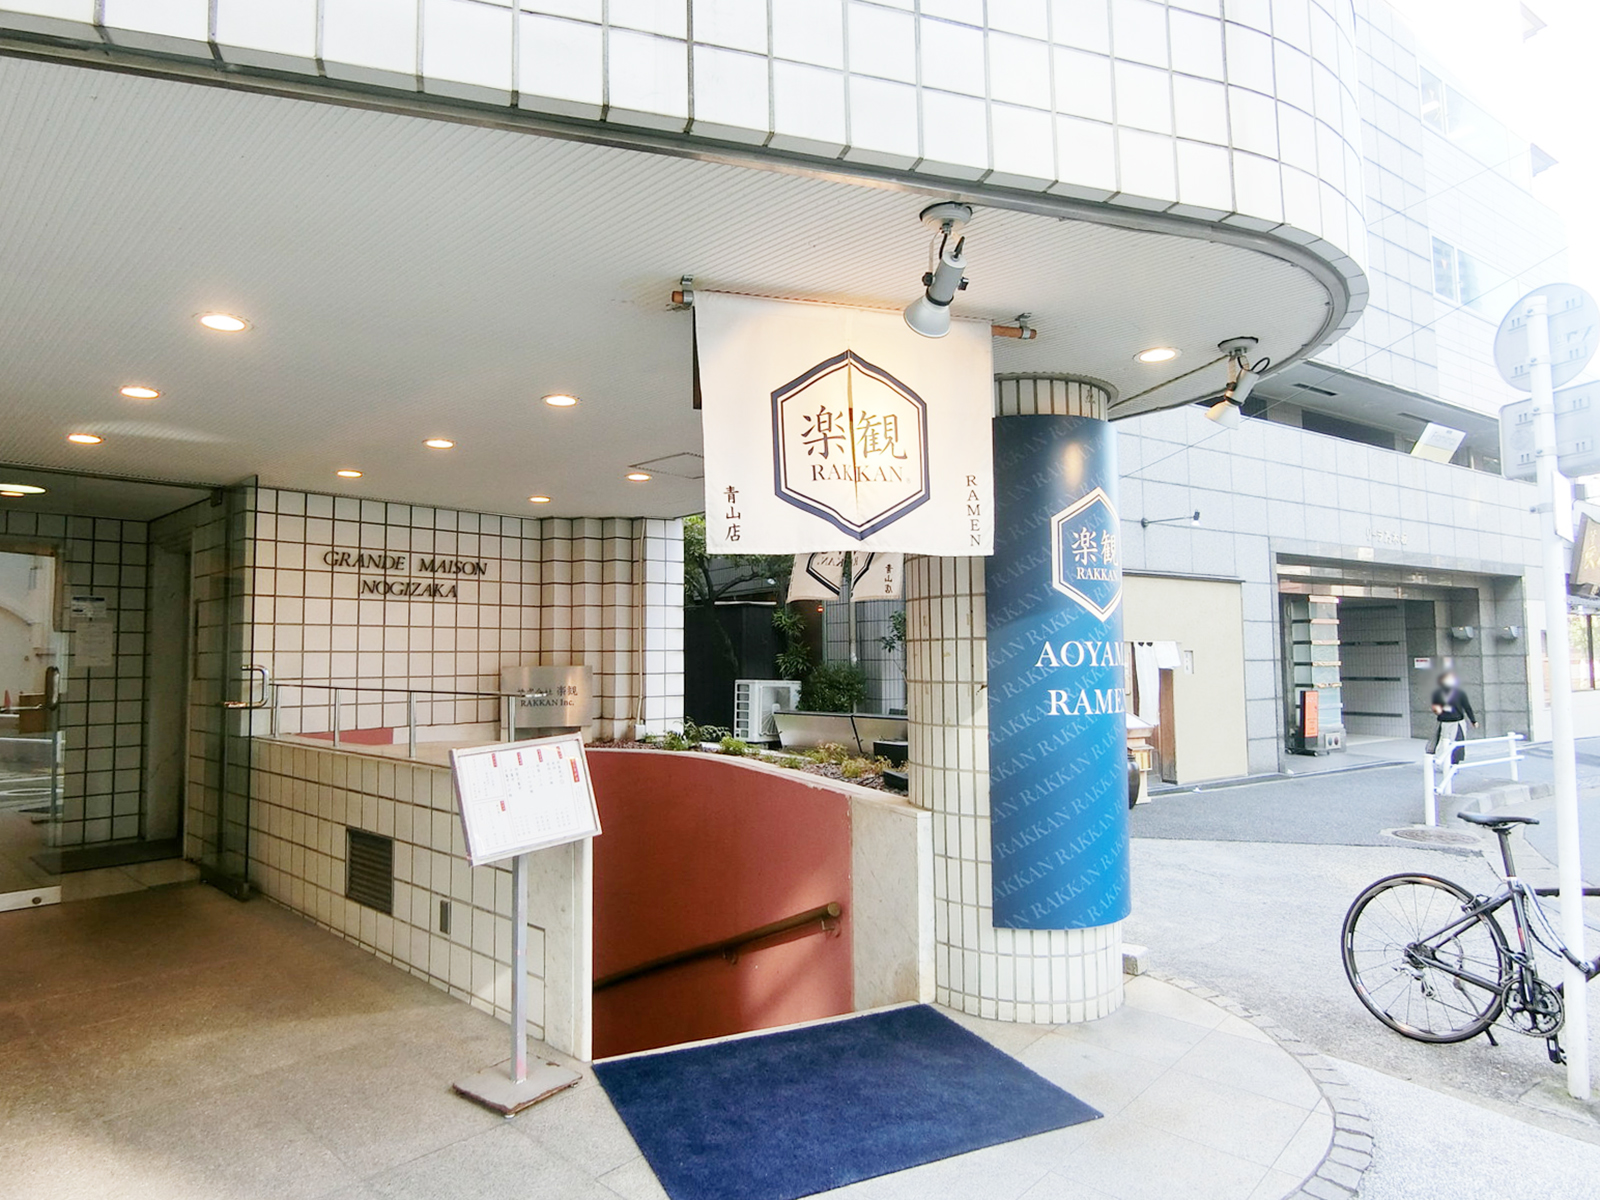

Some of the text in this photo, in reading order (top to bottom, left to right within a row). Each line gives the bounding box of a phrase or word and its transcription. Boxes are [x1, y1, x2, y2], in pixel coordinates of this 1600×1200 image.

[800, 404, 908, 460] 楽観
[811, 464, 904, 483] RAKKAN
[723, 484, 742, 542] 青山店
[966, 474, 982, 547] RAMEN
[322, 550, 488, 576] GRANDE MAISON
[360, 579, 458, 599] NOGIZAKA
[520, 699, 558, 707] RAKKAN
[994, 808, 1071, 860] RAKKAN
[1030, 864, 1101, 920] RAKKAN
